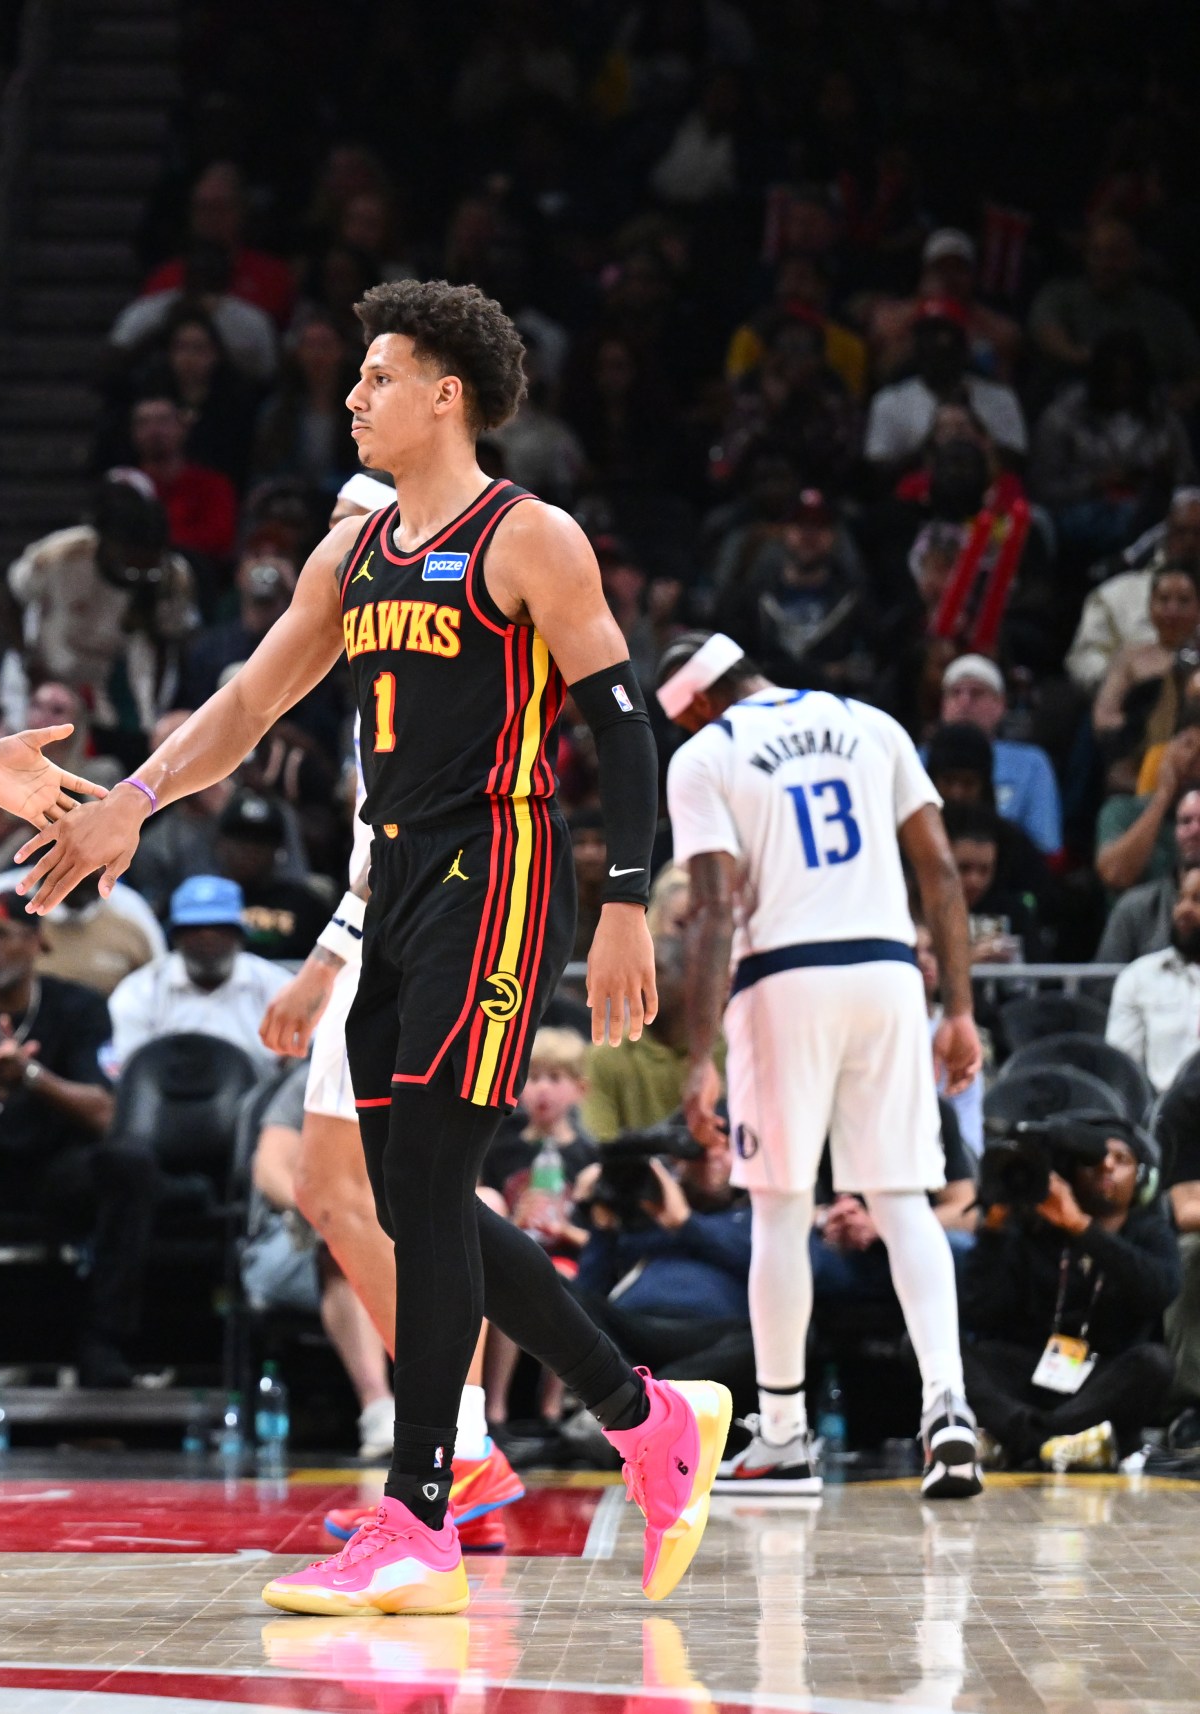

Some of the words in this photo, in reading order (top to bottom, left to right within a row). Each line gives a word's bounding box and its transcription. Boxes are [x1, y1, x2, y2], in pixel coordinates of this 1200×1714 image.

[427, 560, 463, 574] paze
[343, 600, 462, 664] HAWKS
[373, 672, 397, 752] 1
[785, 779, 861, 868] 13
